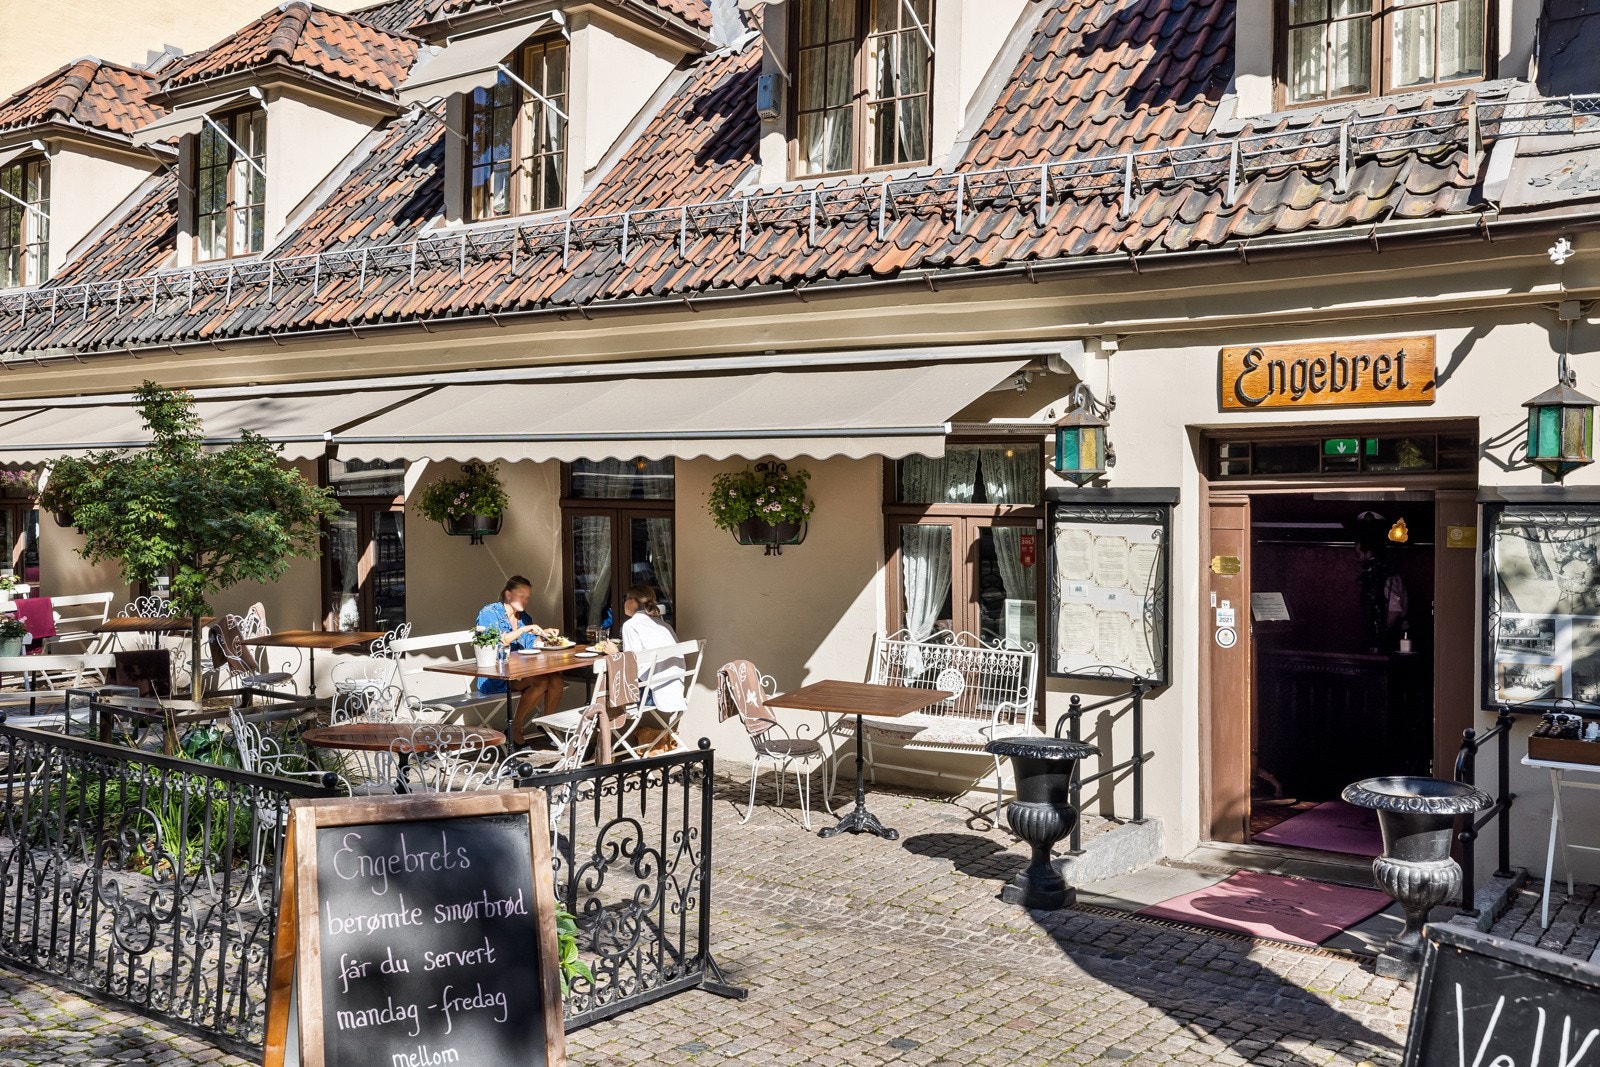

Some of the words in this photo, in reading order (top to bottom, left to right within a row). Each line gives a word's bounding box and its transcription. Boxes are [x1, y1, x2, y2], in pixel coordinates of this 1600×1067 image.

[1235, 347, 1409, 405] Engebret
[333, 830, 471, 896] Engebrets
[326, 893, 423, 936] berømte
[435, 888, 528, 925] smørbrød
[338, 953, 372, 994] får
[381, 947, 409, 975] du
[424, 936, 496, 970] servert
[336, 998, 419, 1037] mandag
[441, 983, 507, 1035] fredag
[391, 1046, 459, 1067] mellom
